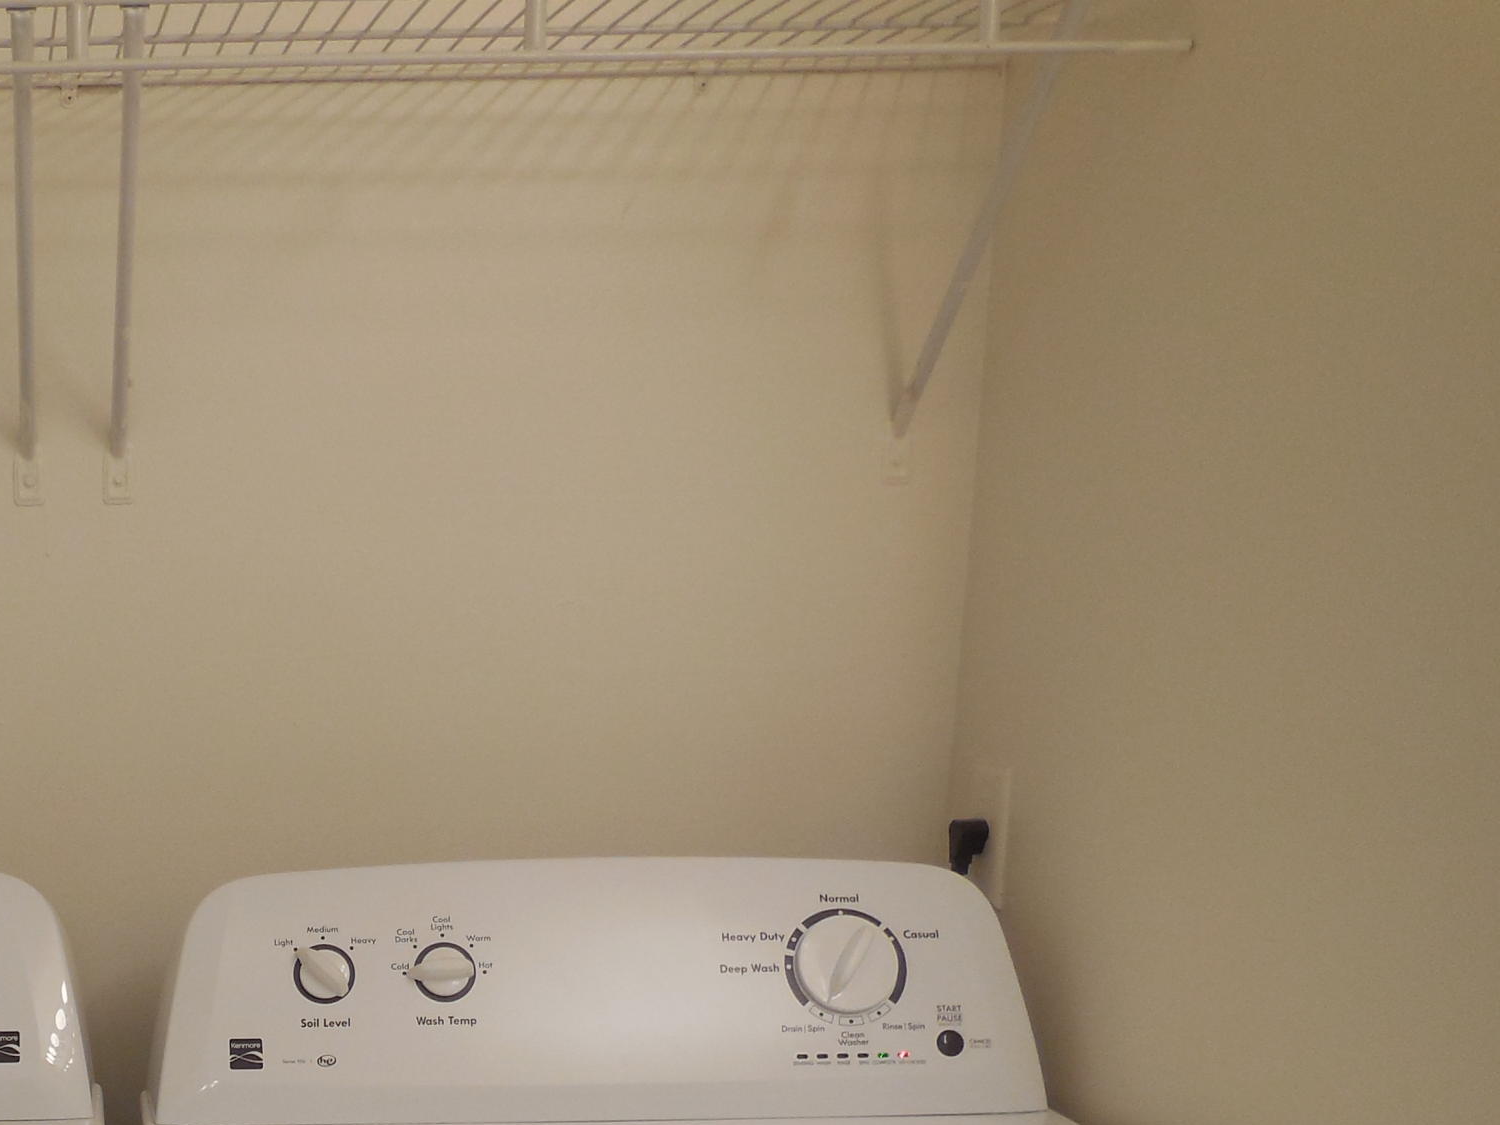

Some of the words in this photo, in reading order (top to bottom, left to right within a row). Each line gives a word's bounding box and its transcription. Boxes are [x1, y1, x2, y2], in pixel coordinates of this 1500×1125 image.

[819, 894, 859, 904] Normal
[430, 923, 453, 932] Lights
[722, 932, 756, 943] Heavy
[760, 932, 785, 942] Duty
[903, 929, 939, 940] Casual
[274, 939, 293, 947] Light
[720, 964, 748, 975] Deep
[751, 963, 780, 973] Wash
[300, 1019, 320, 1028] Soil
[324, 1018, 350, 1028] Level
[416, 1016, 444, 1026] Wash
[448, 1016, 477, 1028] Temp
[808, 1025, 826, 1033] Spin
